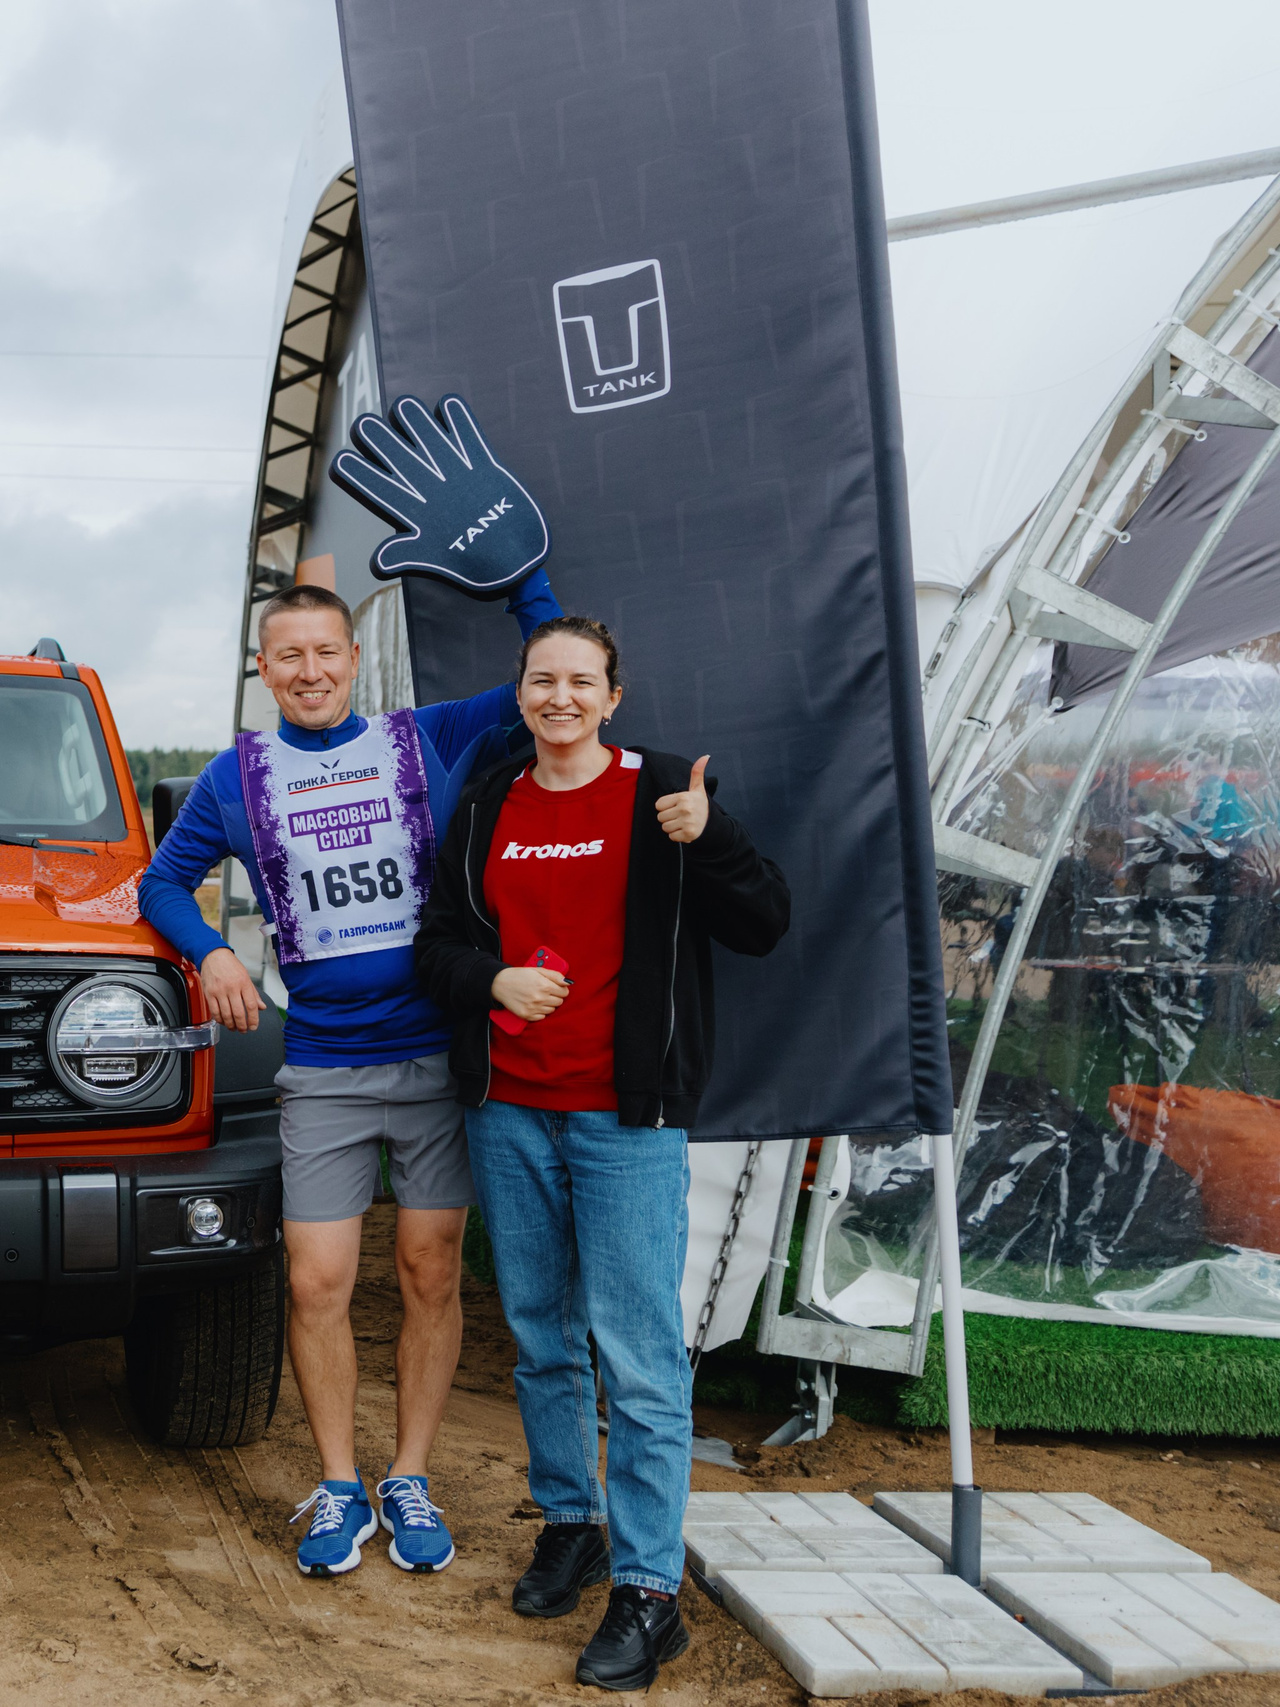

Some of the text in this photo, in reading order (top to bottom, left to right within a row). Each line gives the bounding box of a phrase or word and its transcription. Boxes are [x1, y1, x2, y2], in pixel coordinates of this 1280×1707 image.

[583, 371, 657, 397] TANK
[449, 497, 514, 552] TANK
[287, 767, 380, 792] ГОНКА ГЕРОЕВ
[292, 798, 388, 834] МАССОВЫЙ
[318, 826, 367, 849] СТАРТ
[501, 839, 605, 859] kronos
[300, 857, 404, 912] 1658
[338, 920, 407, 939] ГАЗПРОМБАНК
